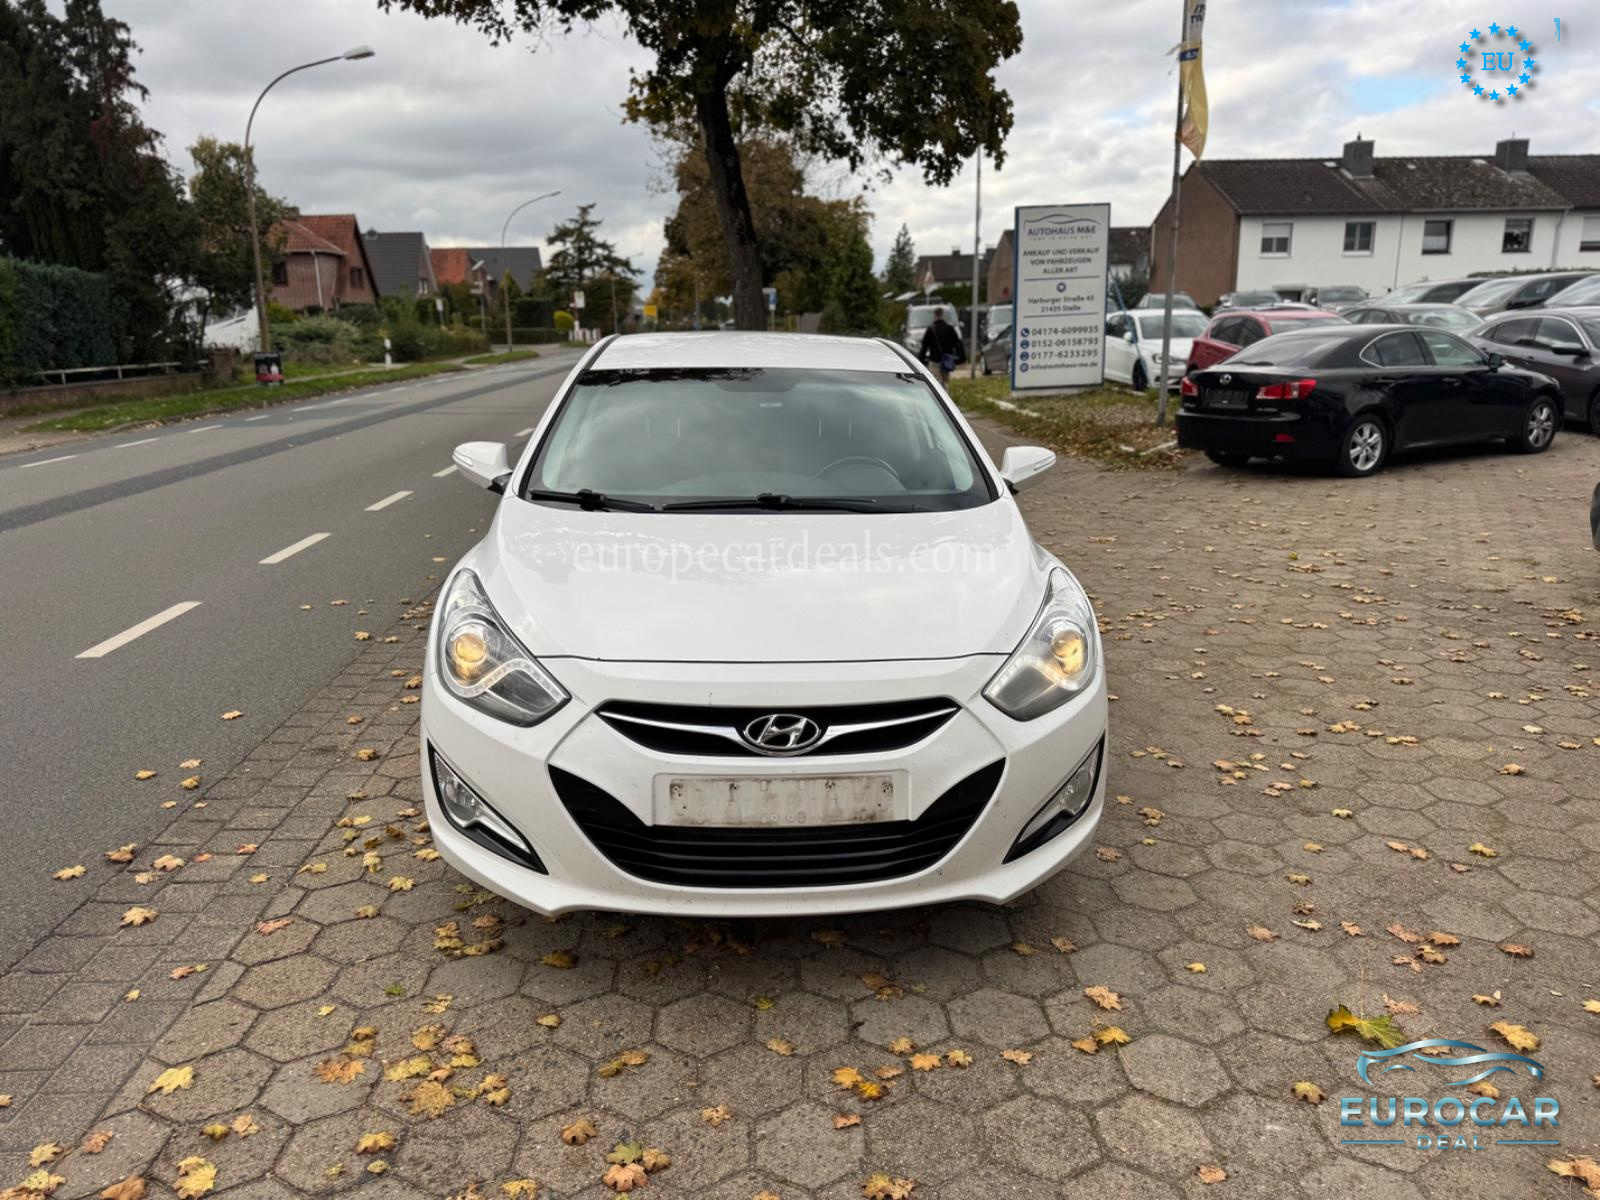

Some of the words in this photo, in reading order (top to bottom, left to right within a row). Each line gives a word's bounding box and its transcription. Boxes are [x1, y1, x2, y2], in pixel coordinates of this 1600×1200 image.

[1027, 227, 1075, 236] AUTOHAUS
[1077, 225, 1096, 234] M&E
[1069, 247, 1100, 255] VERKAUF
[1030, 258, 1045, 266] VON
